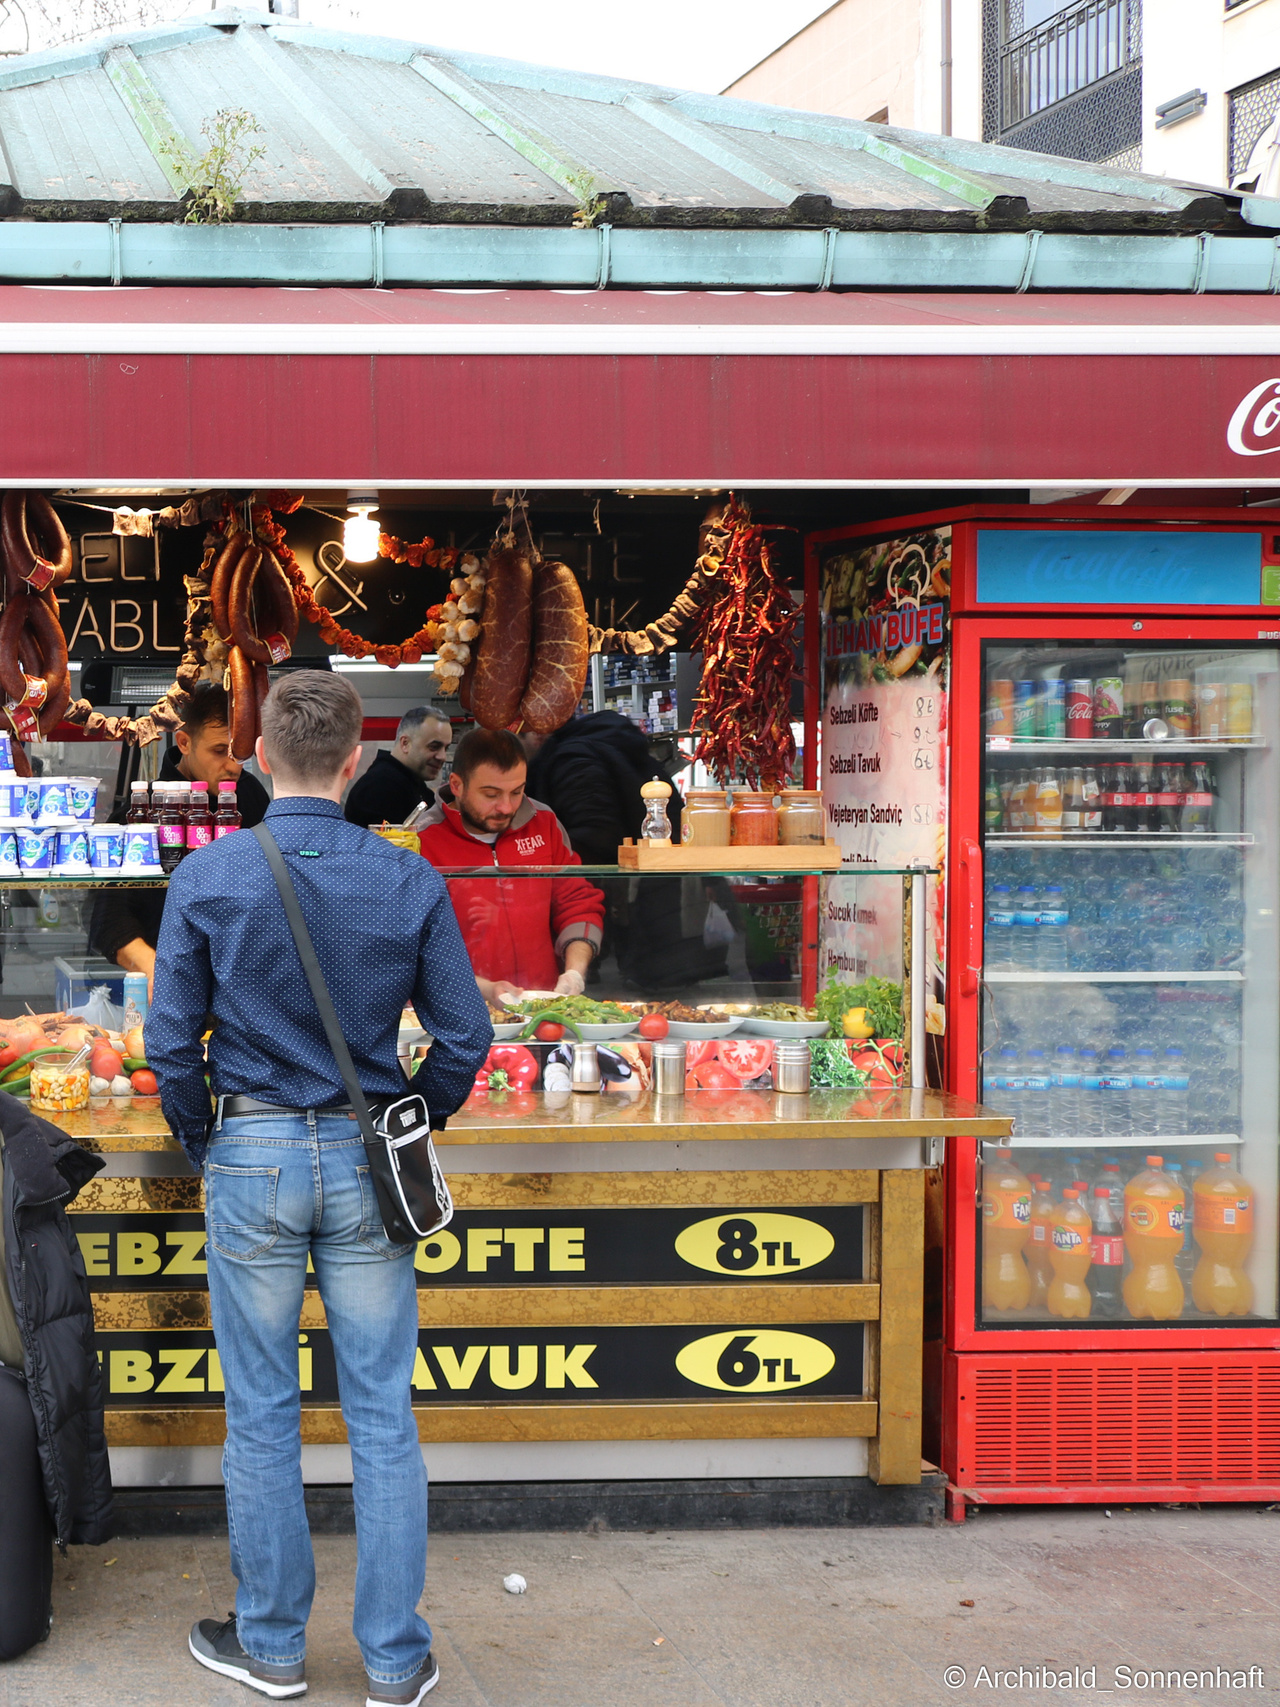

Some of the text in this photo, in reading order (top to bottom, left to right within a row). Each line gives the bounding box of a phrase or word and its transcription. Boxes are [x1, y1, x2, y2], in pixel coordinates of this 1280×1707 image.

[887, 603, 942, 647] BÜFE
[830, 703, 857, 726] Sebzeli
[859, 701, 879, 723] Köfte
[1068, 702, 1093, 719] Cola
[829, 753, 856, 775] Sebzeli
[858, 752, 881, 773] Tavuk
[829, 803, 868, 828] Vejeteryan
[870, 802, 902, 827] Sandviç
[828, 901, 852, 922] Sucuk
[1012, 1201, 1031, 1220] FAN
[1052, 1229, 1082, 1246] FANTA
[410, 1344, 599, 1391] AVUK
